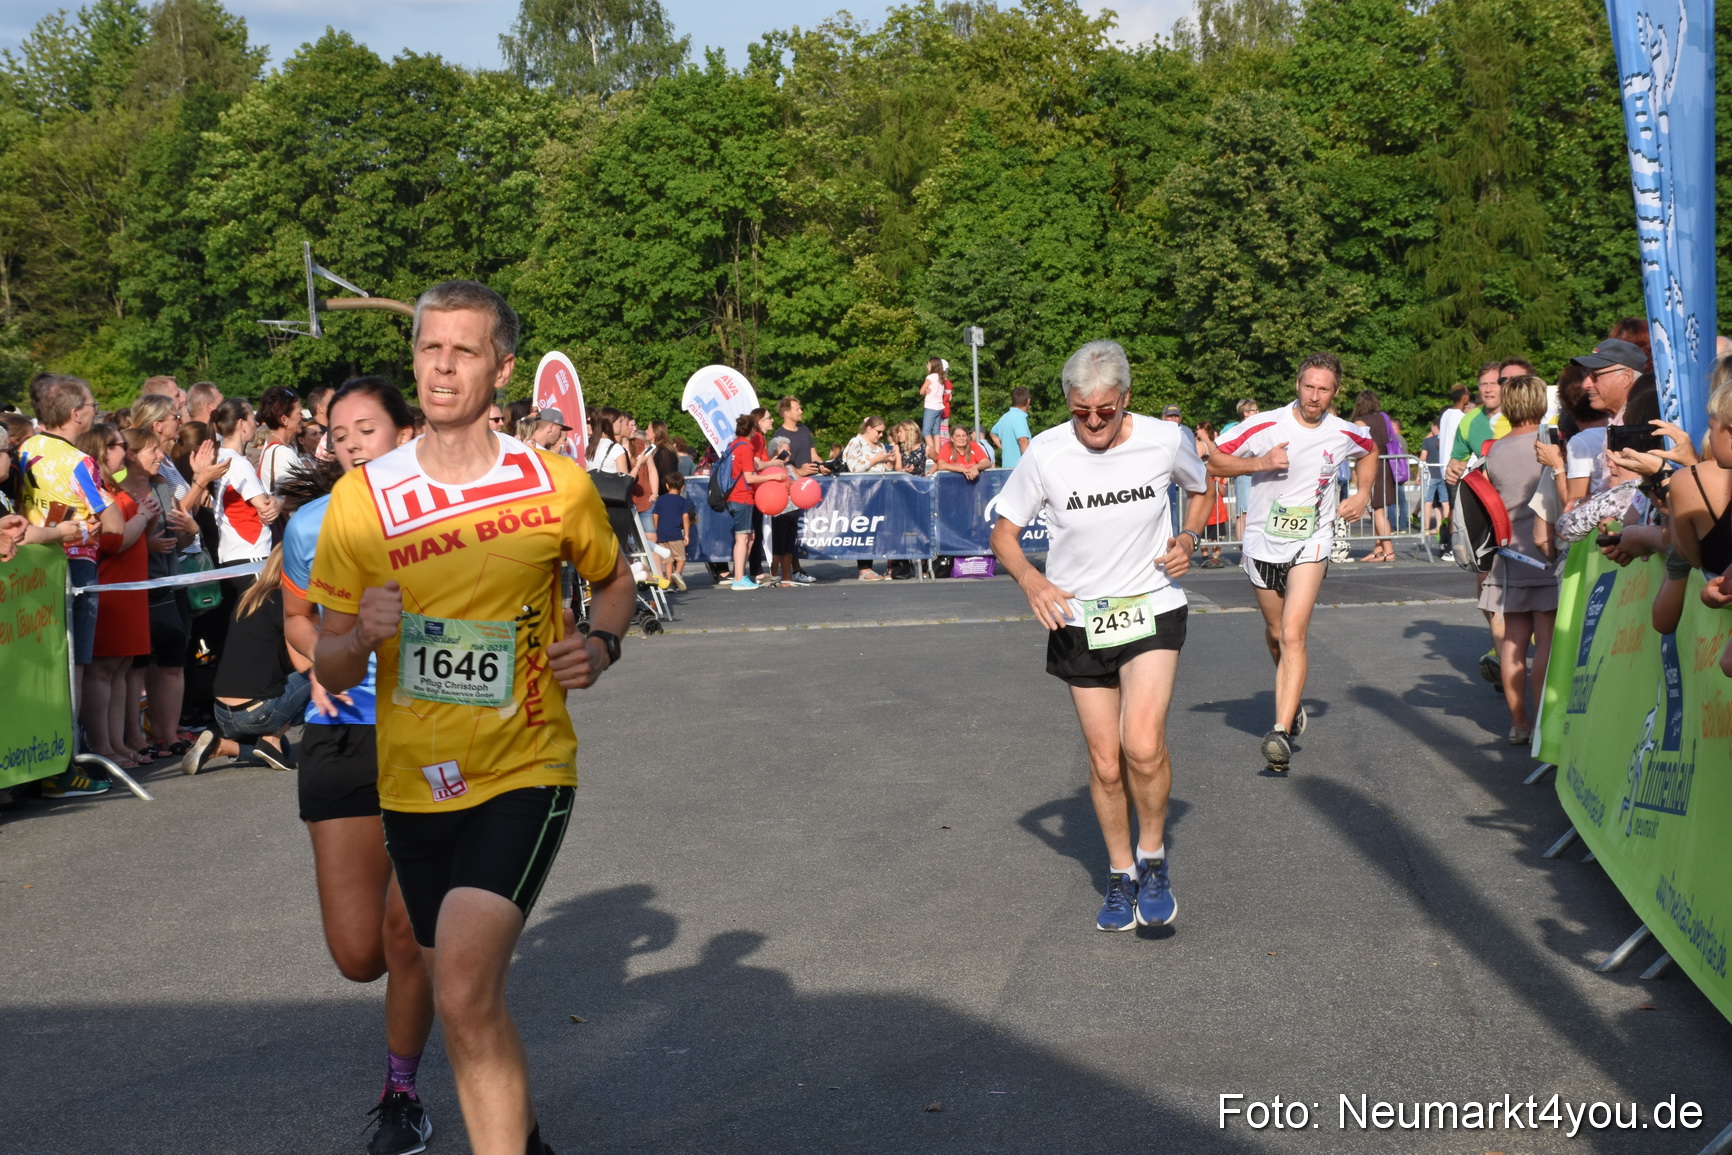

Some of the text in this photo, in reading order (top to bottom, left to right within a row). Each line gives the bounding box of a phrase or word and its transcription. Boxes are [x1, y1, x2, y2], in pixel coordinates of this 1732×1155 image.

[1087, 485, 1156, 508] MAGNA
[797, 510, 885, 534] scher
[1272, 516, 1308, 531] 1792
[388, 505, 561, 571] MAX BÖGL
[796, 536, 875, 547] TOMOBILE
[1092, 608, 1146, 635] 2434
[413, 646, 499, 683] 1646
[420, 677, 489, 695] Pflug Christoph
[0, 730, 66, 775] -oberpfalz.de
